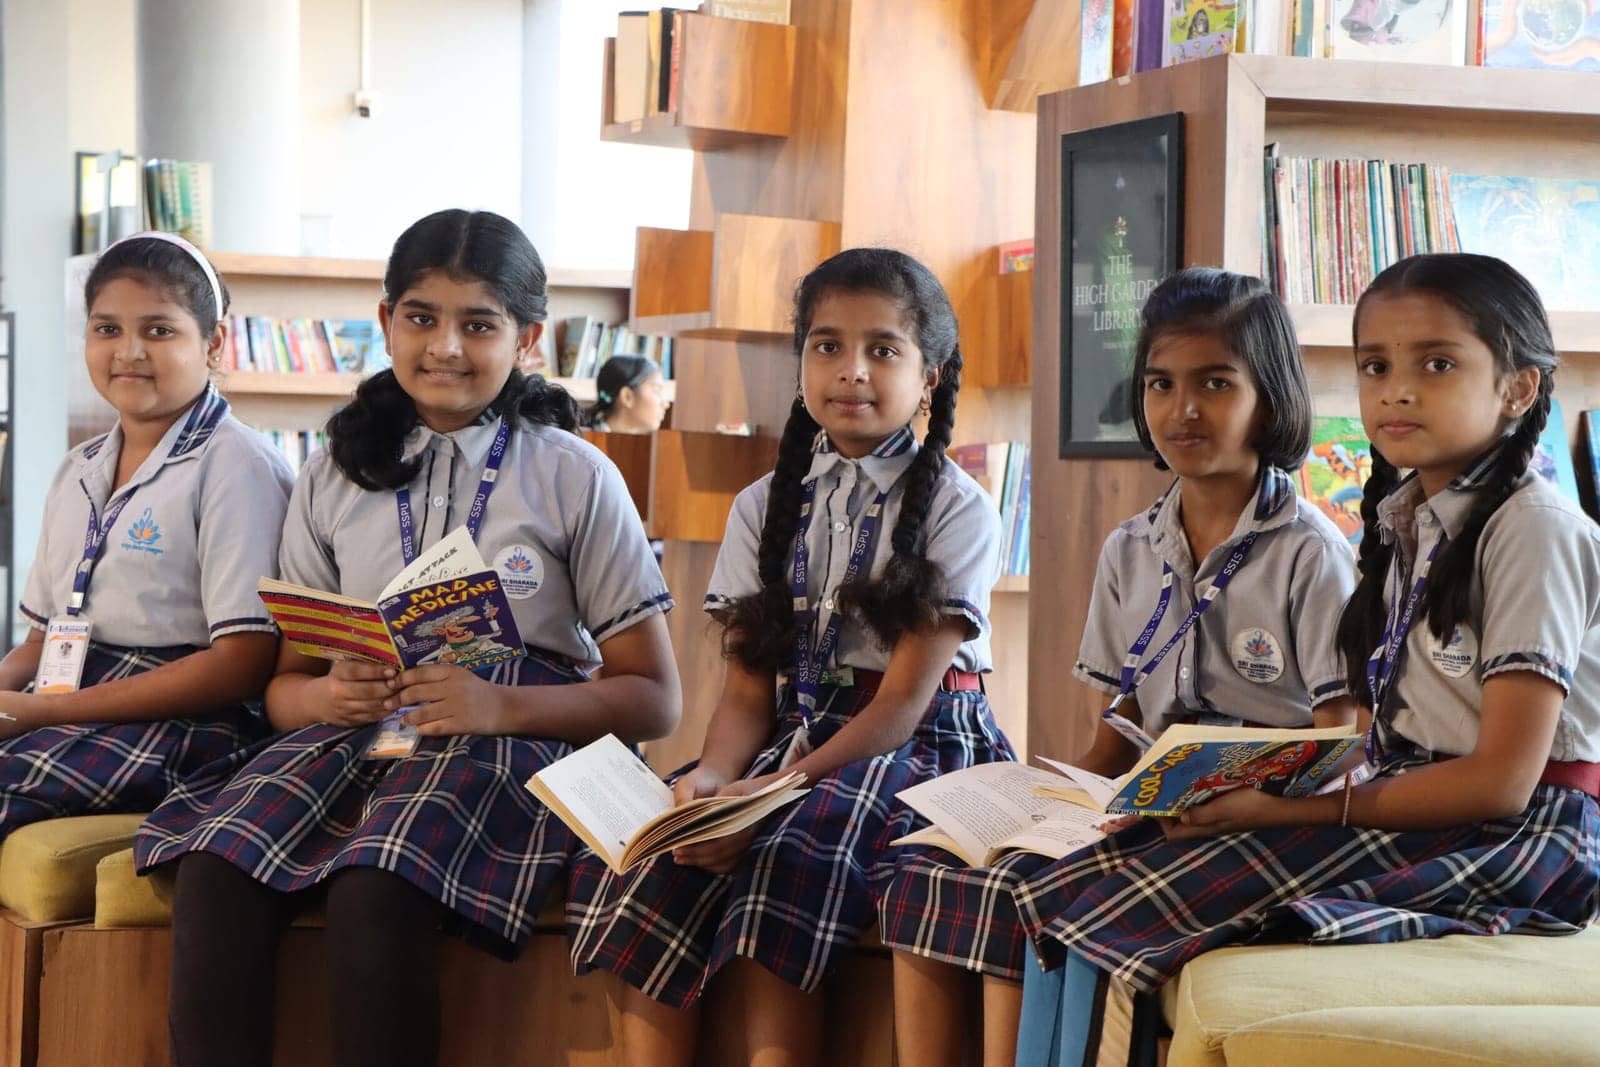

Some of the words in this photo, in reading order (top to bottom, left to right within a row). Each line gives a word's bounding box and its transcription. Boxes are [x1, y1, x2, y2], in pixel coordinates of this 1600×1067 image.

[1107, 254, 1133, 276] THE
[1074, 283, 1109, 306] HIGH
[491, 436, 506, 457] SSIS
[400, 502, 411, 528] SSPU
[470, 493, 486, 519] SSPU
[404, 535, 413, 559] SSIS
[855, 529, 870, 556] SSPU
[419, 546, 459, 577] ATTACK
[796, 561, 805, 584] SSIS
[1223, 551, 1244, 576] SSIS
[410, 580, 468, 604] MAD
[390, 580, 498, 629] MEDICINE
[1178, 611, 1200, 634] SSPU
[1137, 627, 1154, 646] SSIS
[1387, 635, 1401, 662] SSIS
[809, 663, 822, 686] SSIS
[820, 627, 837, 653] SSPU
[799, 661, 809, 682] SSIS
[1133, 771, 1162, 808] COOL
[1148, 743, 1205, 774] CARS
